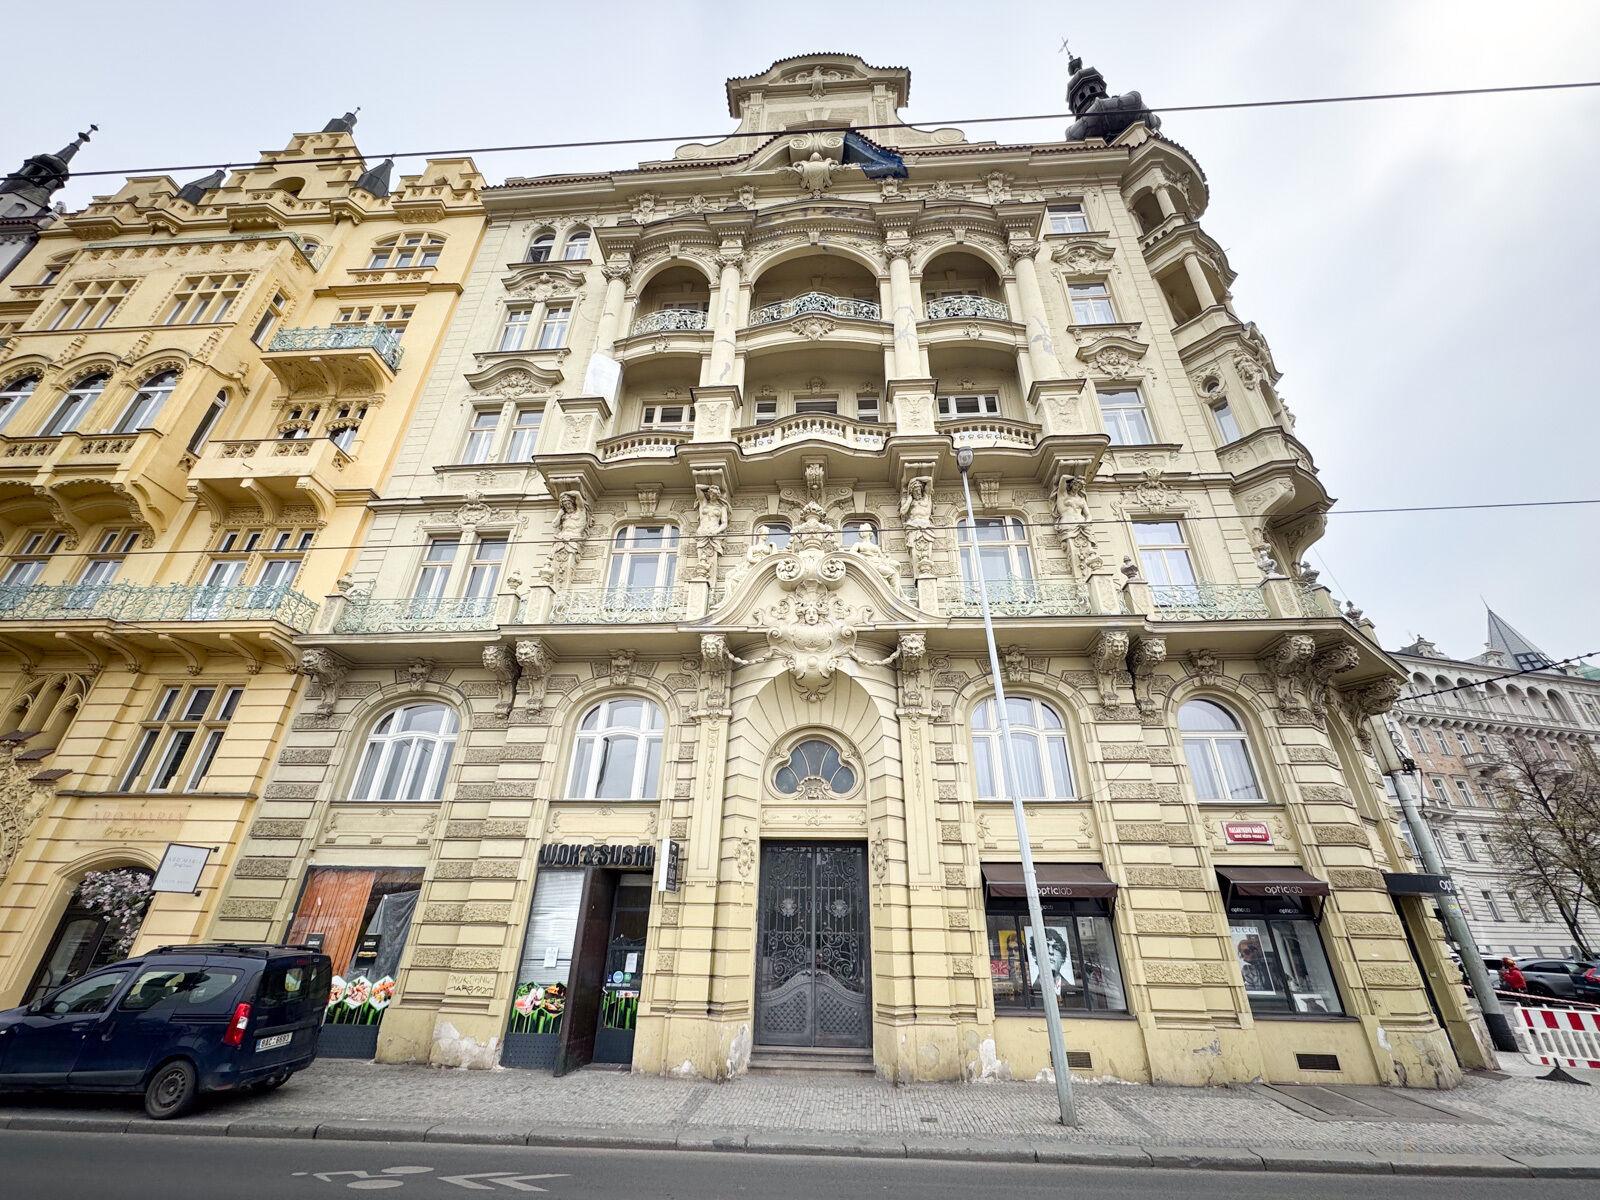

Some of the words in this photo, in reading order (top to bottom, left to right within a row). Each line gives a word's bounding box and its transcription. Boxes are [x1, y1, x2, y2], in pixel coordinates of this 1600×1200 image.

[539, 844, 582, 867] WOK
[597, 844, 656, 867] SUSHI
[1264, 884, 1303, 895] opticlab
